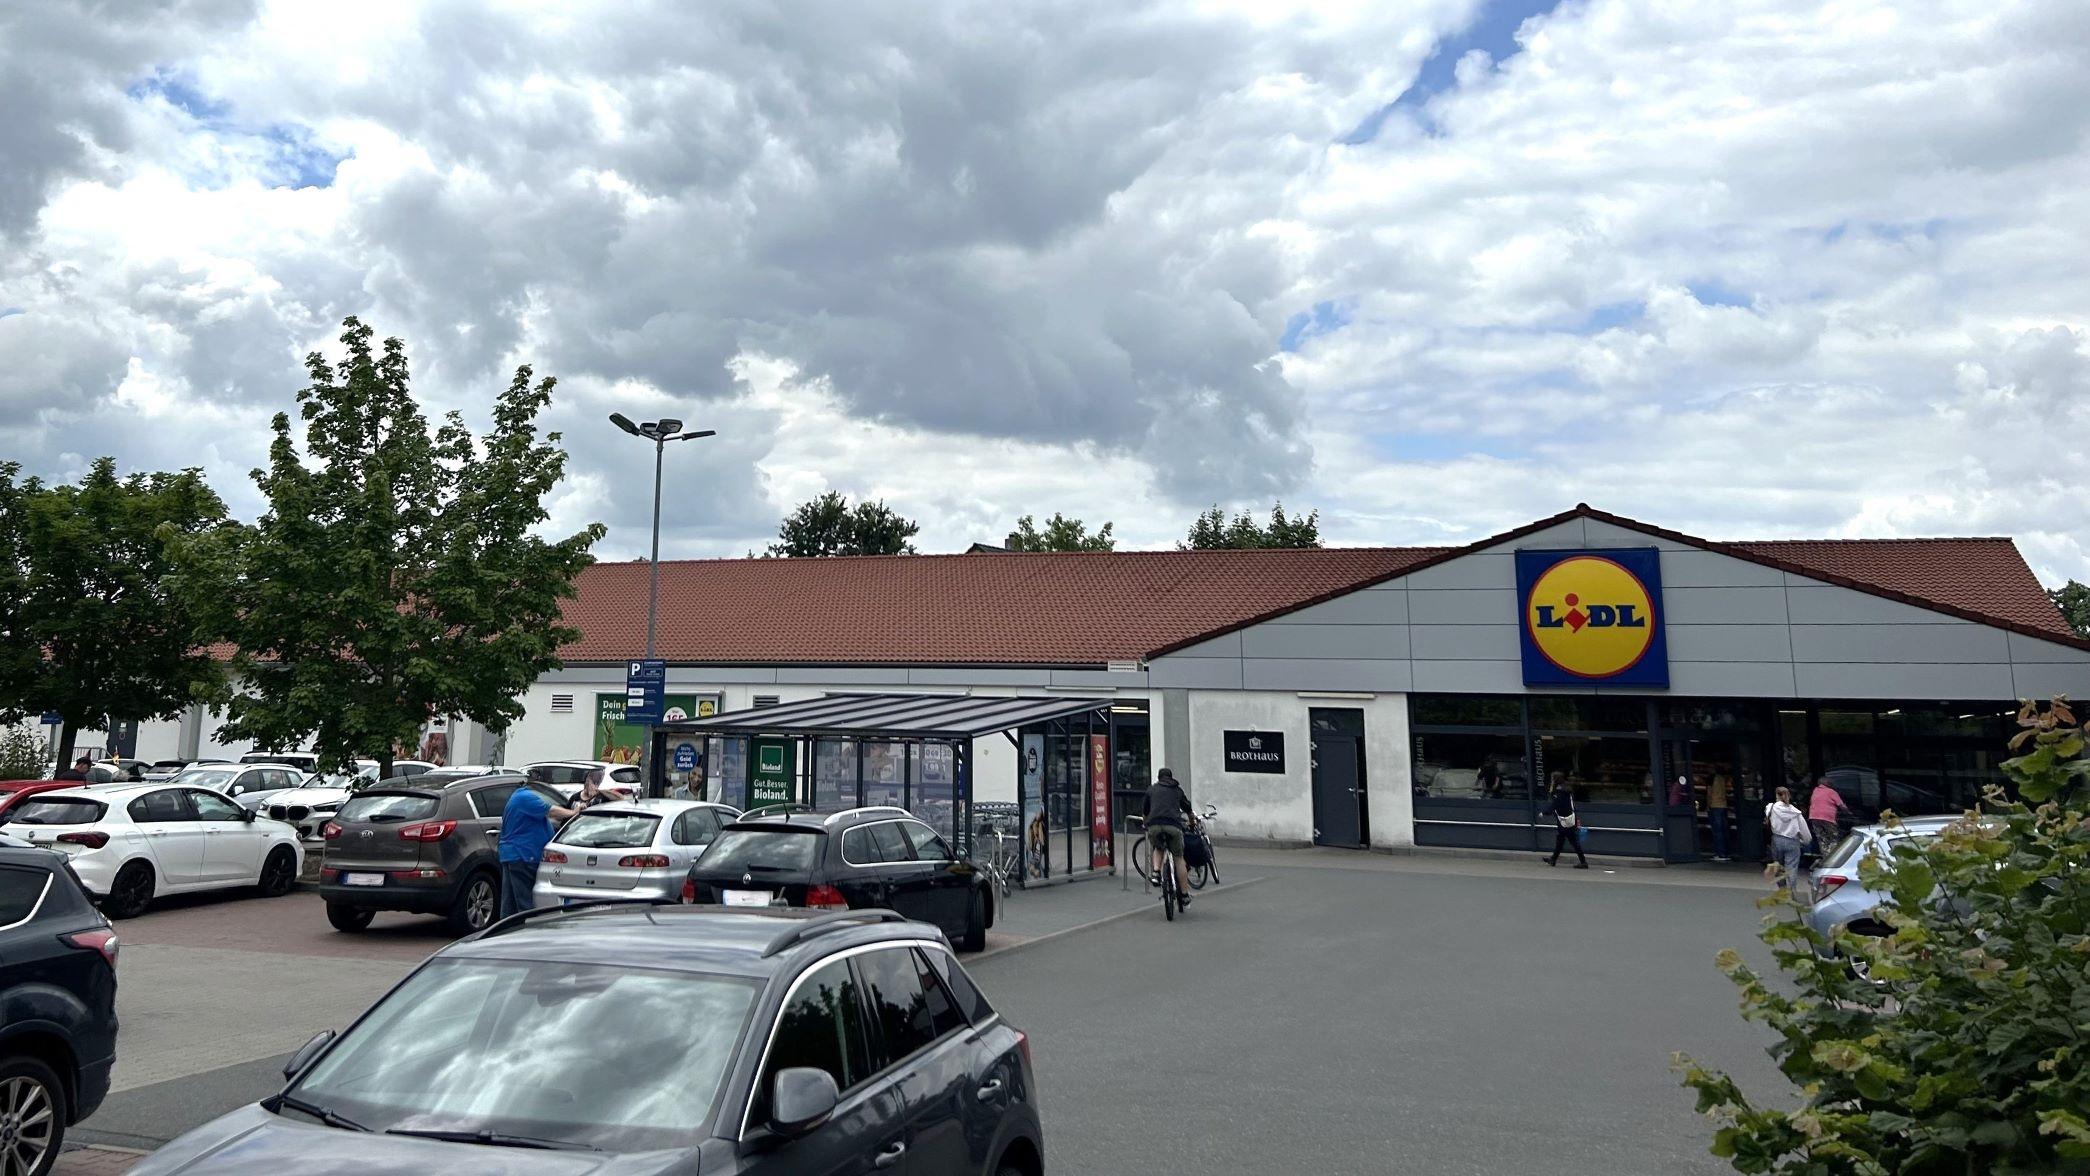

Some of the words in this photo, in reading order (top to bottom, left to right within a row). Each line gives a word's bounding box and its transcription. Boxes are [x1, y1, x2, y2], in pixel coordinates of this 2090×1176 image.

[631, 663, 640, 676] P
[602, 701, 621, 709] Dein
[754, 789, 788, 800] Bioland.
